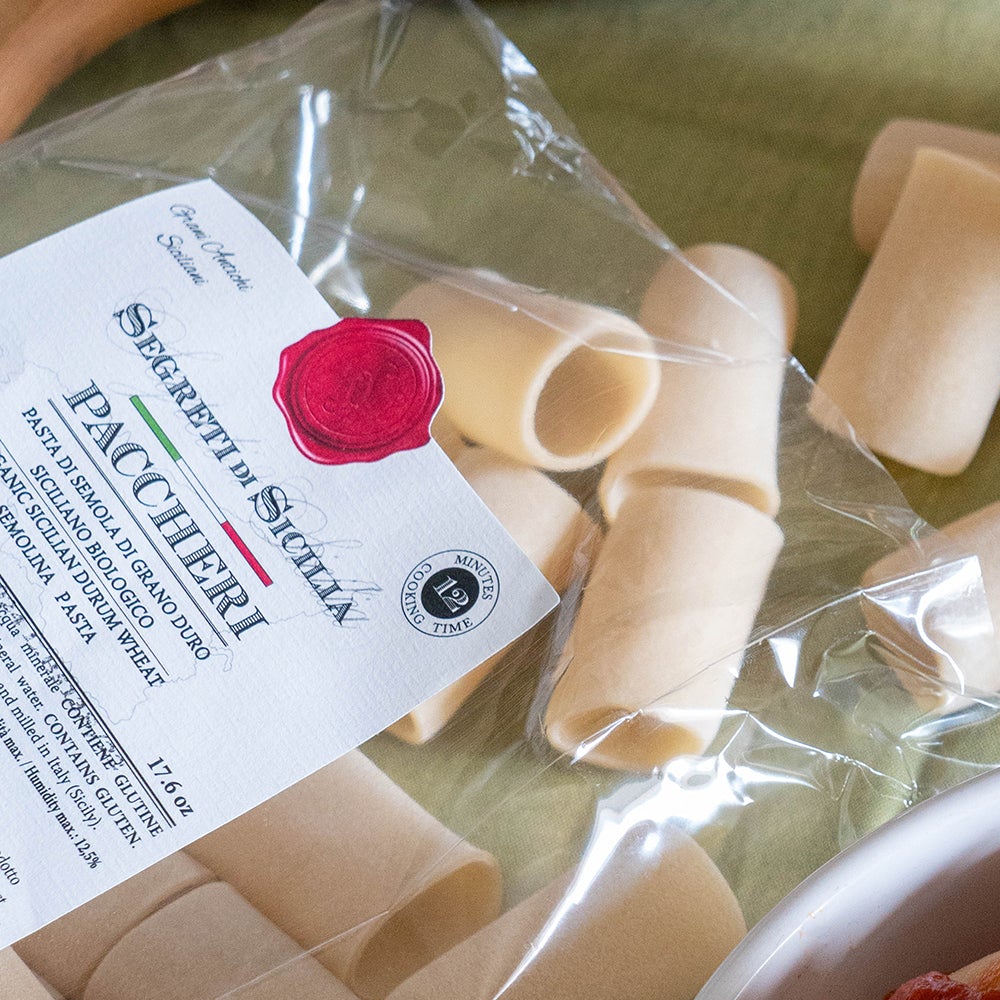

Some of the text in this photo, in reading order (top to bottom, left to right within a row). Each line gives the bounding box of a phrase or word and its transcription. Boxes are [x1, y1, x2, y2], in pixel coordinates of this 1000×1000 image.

[157, 234, 208, 285] Siciliani
[21, 406, 211, 661] PASTA DI SEMOLA DI GRANO DURO
[62, 379, 270, 642] PACCHERI
[112, 302, 241, 463] SEGRETI
[246, 484, 354, 627] SICILIA
[0, 504, 56, 586] SEMOLINA
[54, 590, 97, 645] PASTA
[25, 503, 82, 571] SICILIAN
[71, 569, 124, 632] DURUM
[116, 627, 166, 688] WHEAT
[29, 464, 93, 542] SICILIANO
[84, 541, 155, 629] BIOLOGICO
[405, 563, 474, 634] COOKING TIME
[432, 554, 494, 613] MINUTES 12
[0, 606, 164, 838] cqua minerale CONTIENE GLUTINE
[10, 706, 45, 745] milled
[37, 742, 51, 758] in
[46, 756, 71, 785] Italy
[65, 784, 103, 831] (Sicily).
[16, 675, 44, 712] water.
[43, 713, 101, 786] CONTAINS
[95, 787, 142, 849] GLUTEN.
[146, 756, 194, 818] 17.6 oz
[2, 737, 24, 763] max.
[24, 765, 61, 814] Humidity
[55, 812, 79, 840] max.:
[74, 838, 102, 869] 12,5%
